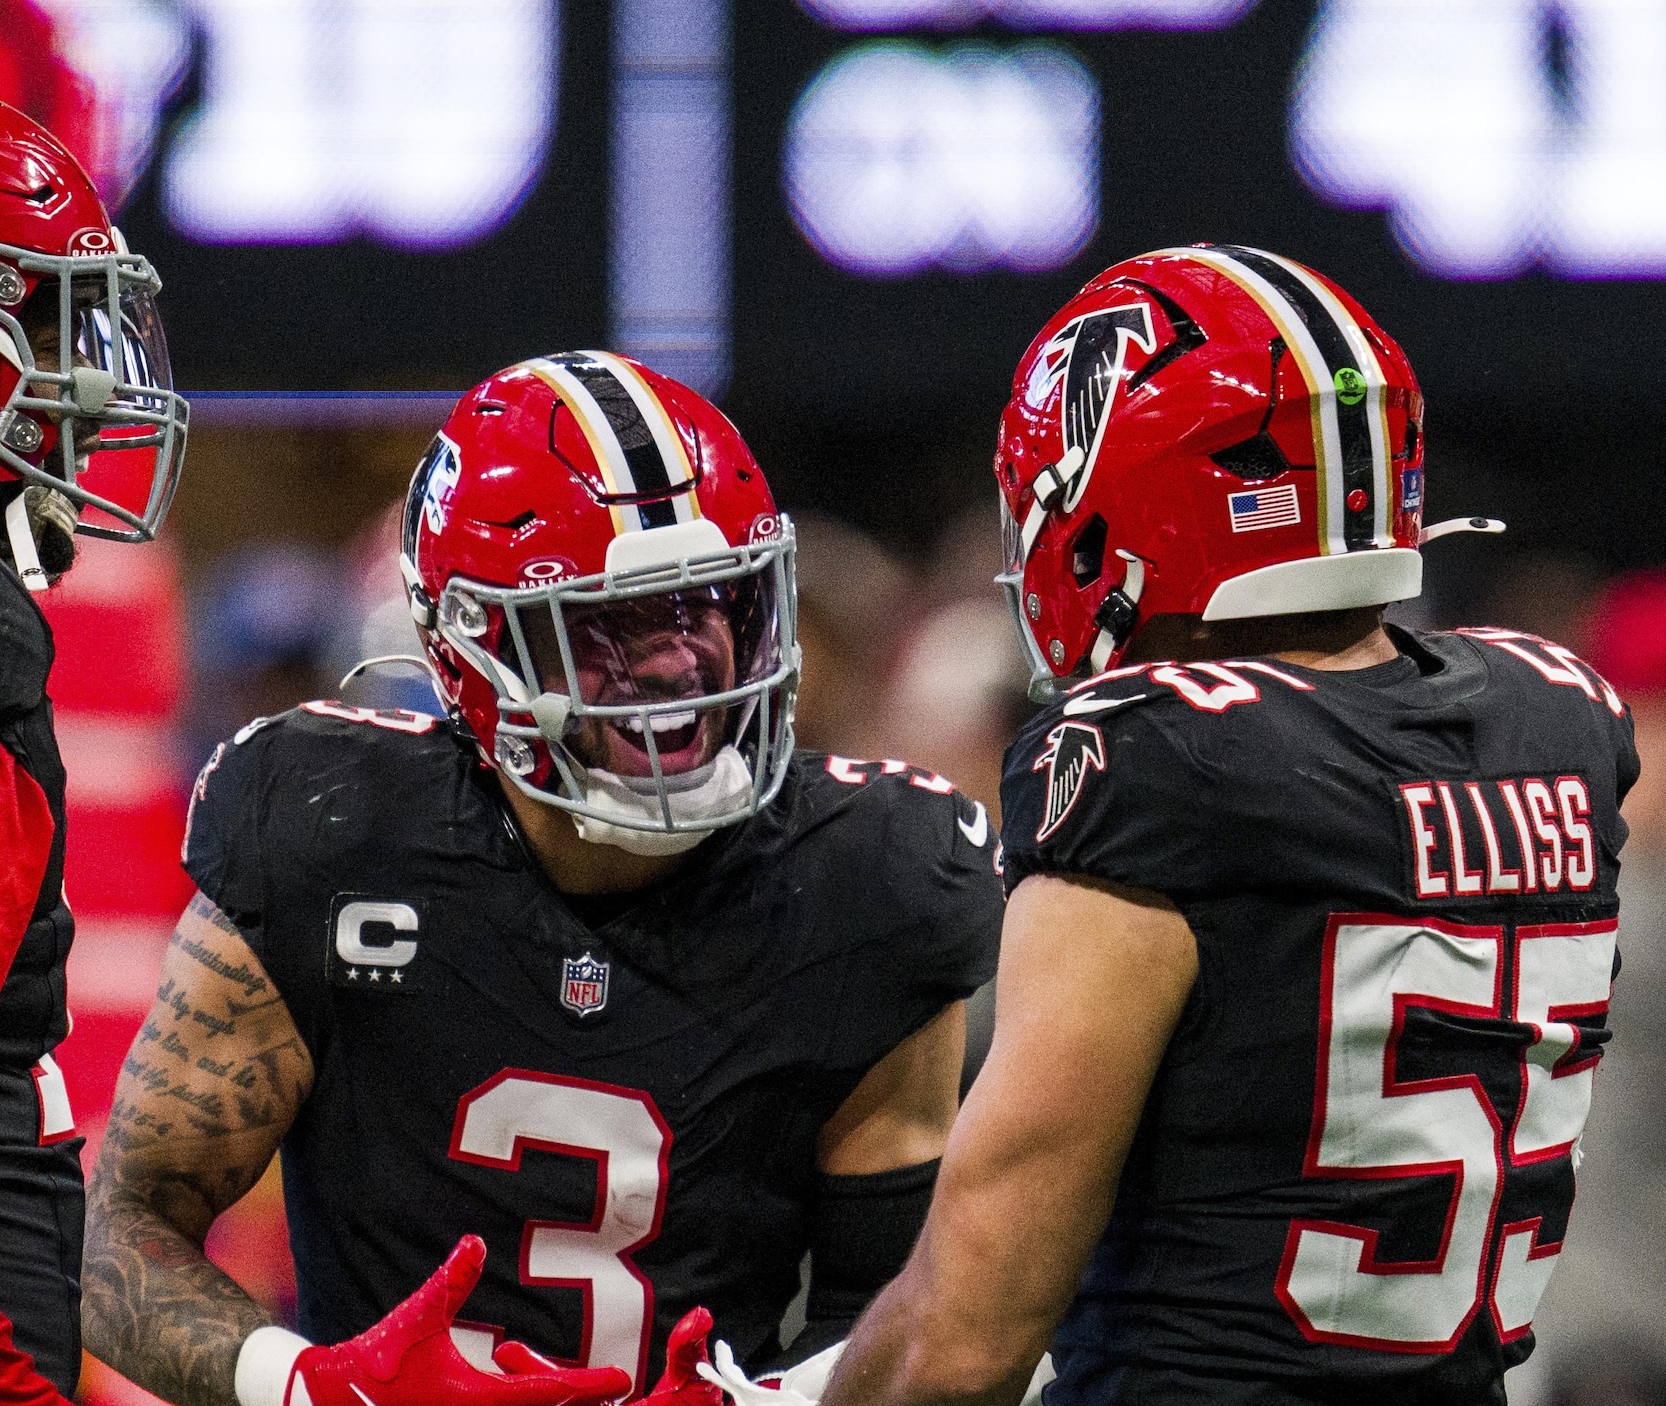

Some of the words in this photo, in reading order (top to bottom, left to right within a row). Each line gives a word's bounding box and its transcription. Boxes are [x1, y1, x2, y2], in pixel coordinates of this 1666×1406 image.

[1398, 775, 1596, 899] ELLISS
[335, 901, 419, 967] C
[567, 981, 601, 1007] NFL
[1275, 911, 1619, 1354] 55
[448, 1067, 673, 1400] 3
